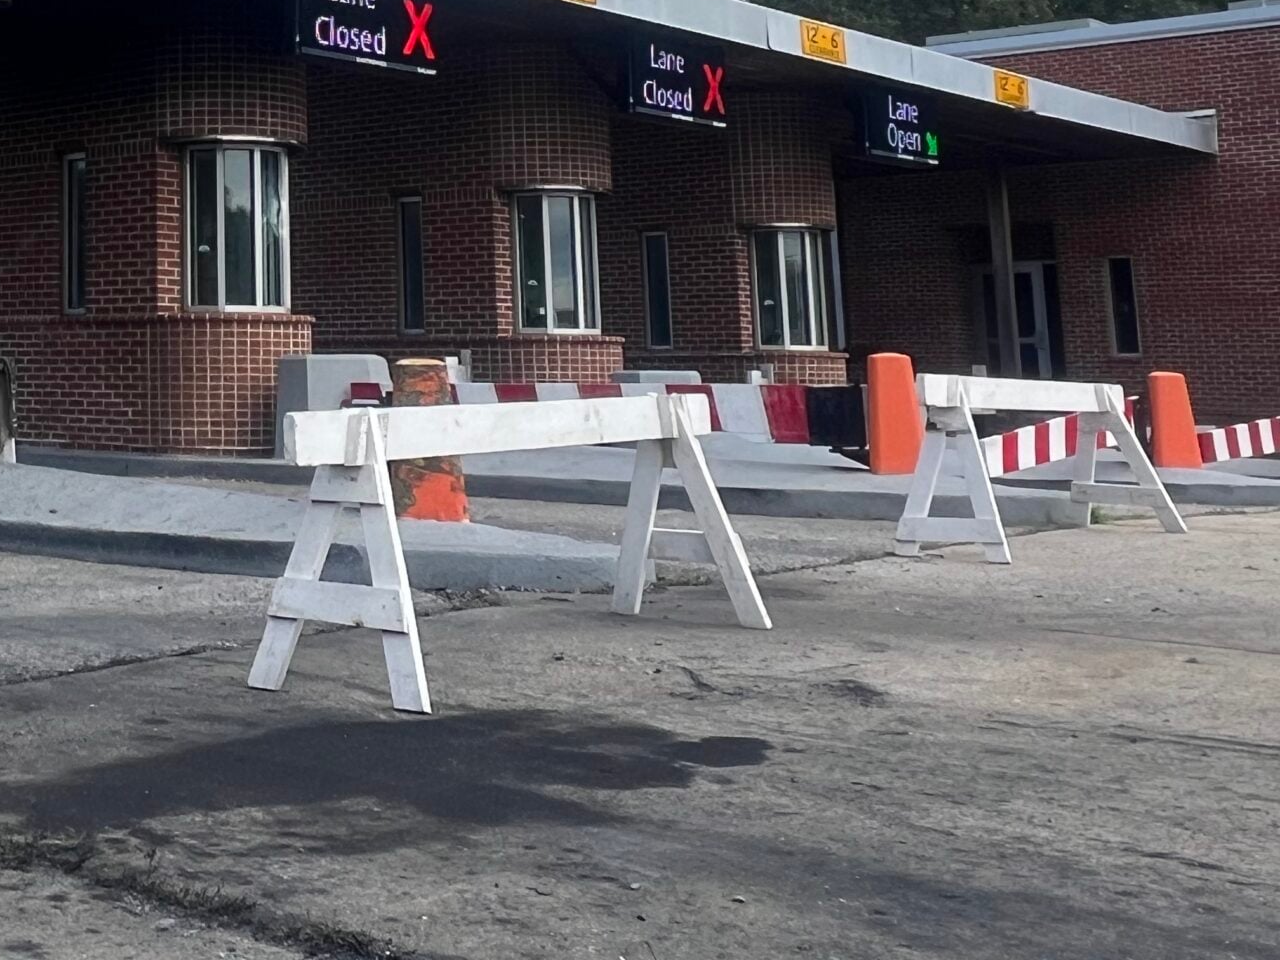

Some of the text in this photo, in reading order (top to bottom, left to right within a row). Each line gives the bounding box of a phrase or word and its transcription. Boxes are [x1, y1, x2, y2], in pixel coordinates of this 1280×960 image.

[314, 15, 387, 56] Closed
[650, 43, 685, 74] Lane
[643, 79, 693, 113] Closed
[887, 94, 919, 125] Lane
[887, 122, 921, 154] Open
